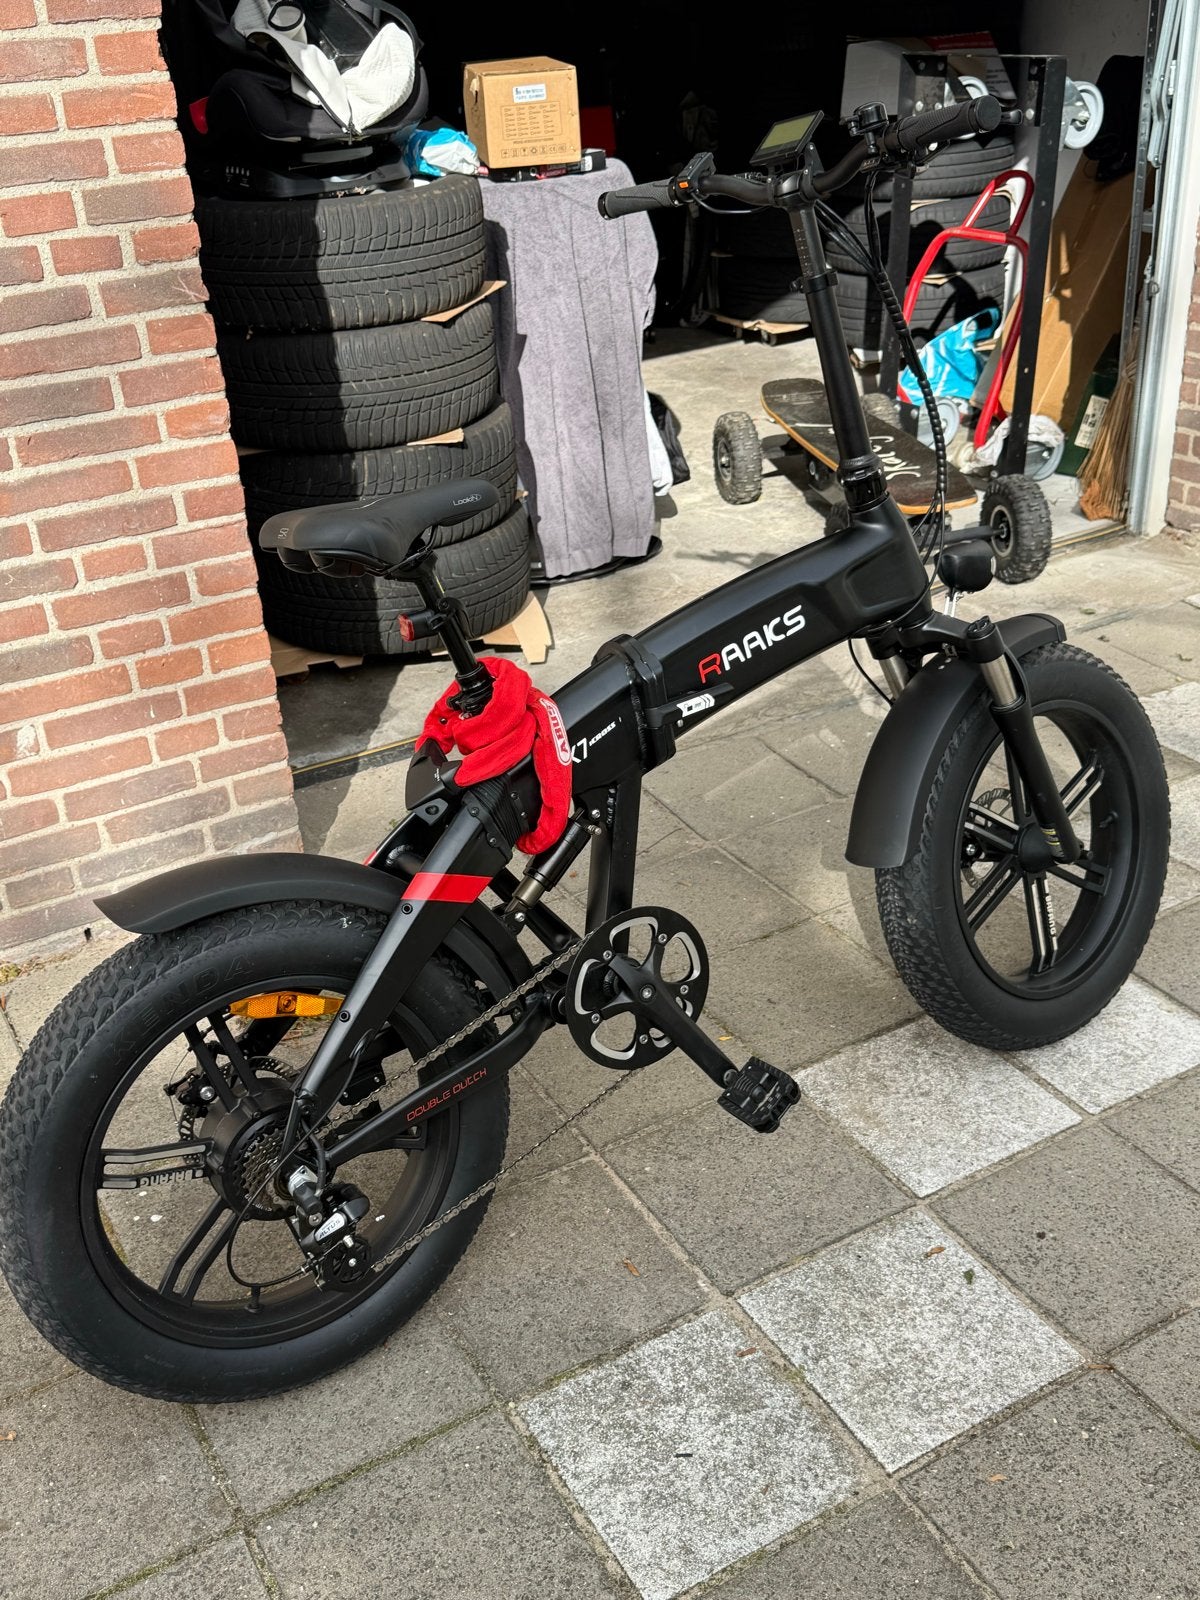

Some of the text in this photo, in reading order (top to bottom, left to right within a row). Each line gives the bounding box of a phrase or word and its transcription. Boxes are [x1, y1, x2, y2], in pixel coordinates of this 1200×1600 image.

[698, 604, 806, 684] RAAKS
[406, 1067, 487, 1122] DOUBLE DUTCH
